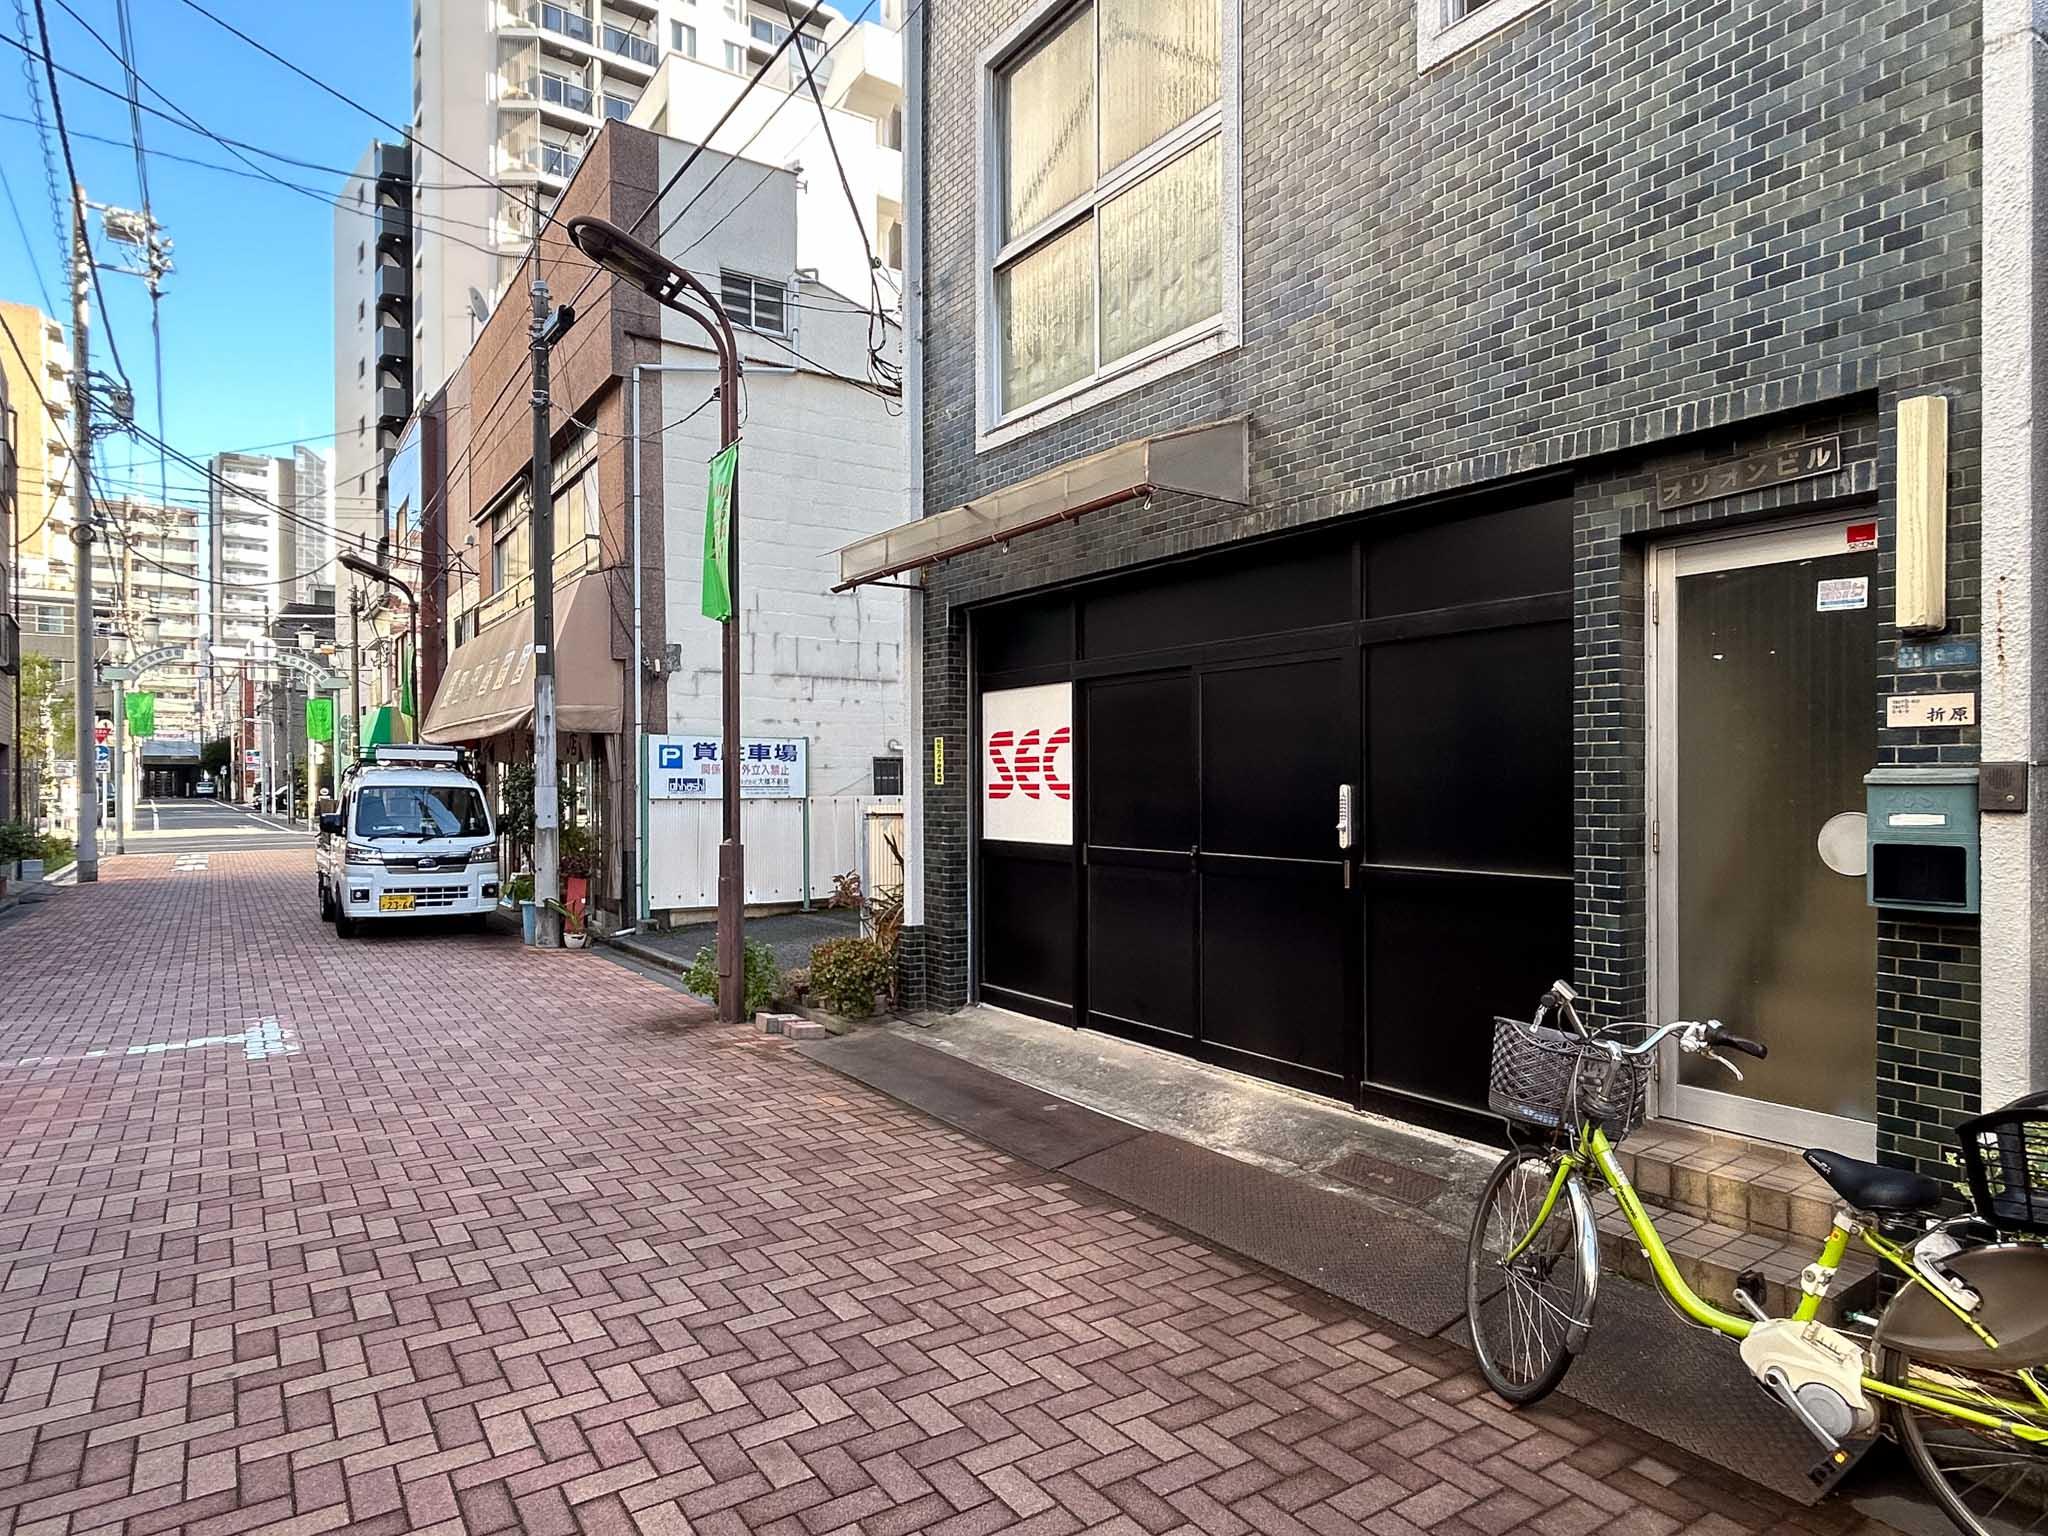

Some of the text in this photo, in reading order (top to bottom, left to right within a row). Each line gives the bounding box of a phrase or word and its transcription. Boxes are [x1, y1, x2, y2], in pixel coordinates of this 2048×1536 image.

[1663, 446, 1832, 503] オリオンビル
[1926, 706, 1969, 723] 折原
[662, 748, 681, 766] P
[988, 726, 1071, 800] SEC
[701, 763, 790, 776] 関係外立入禁止
